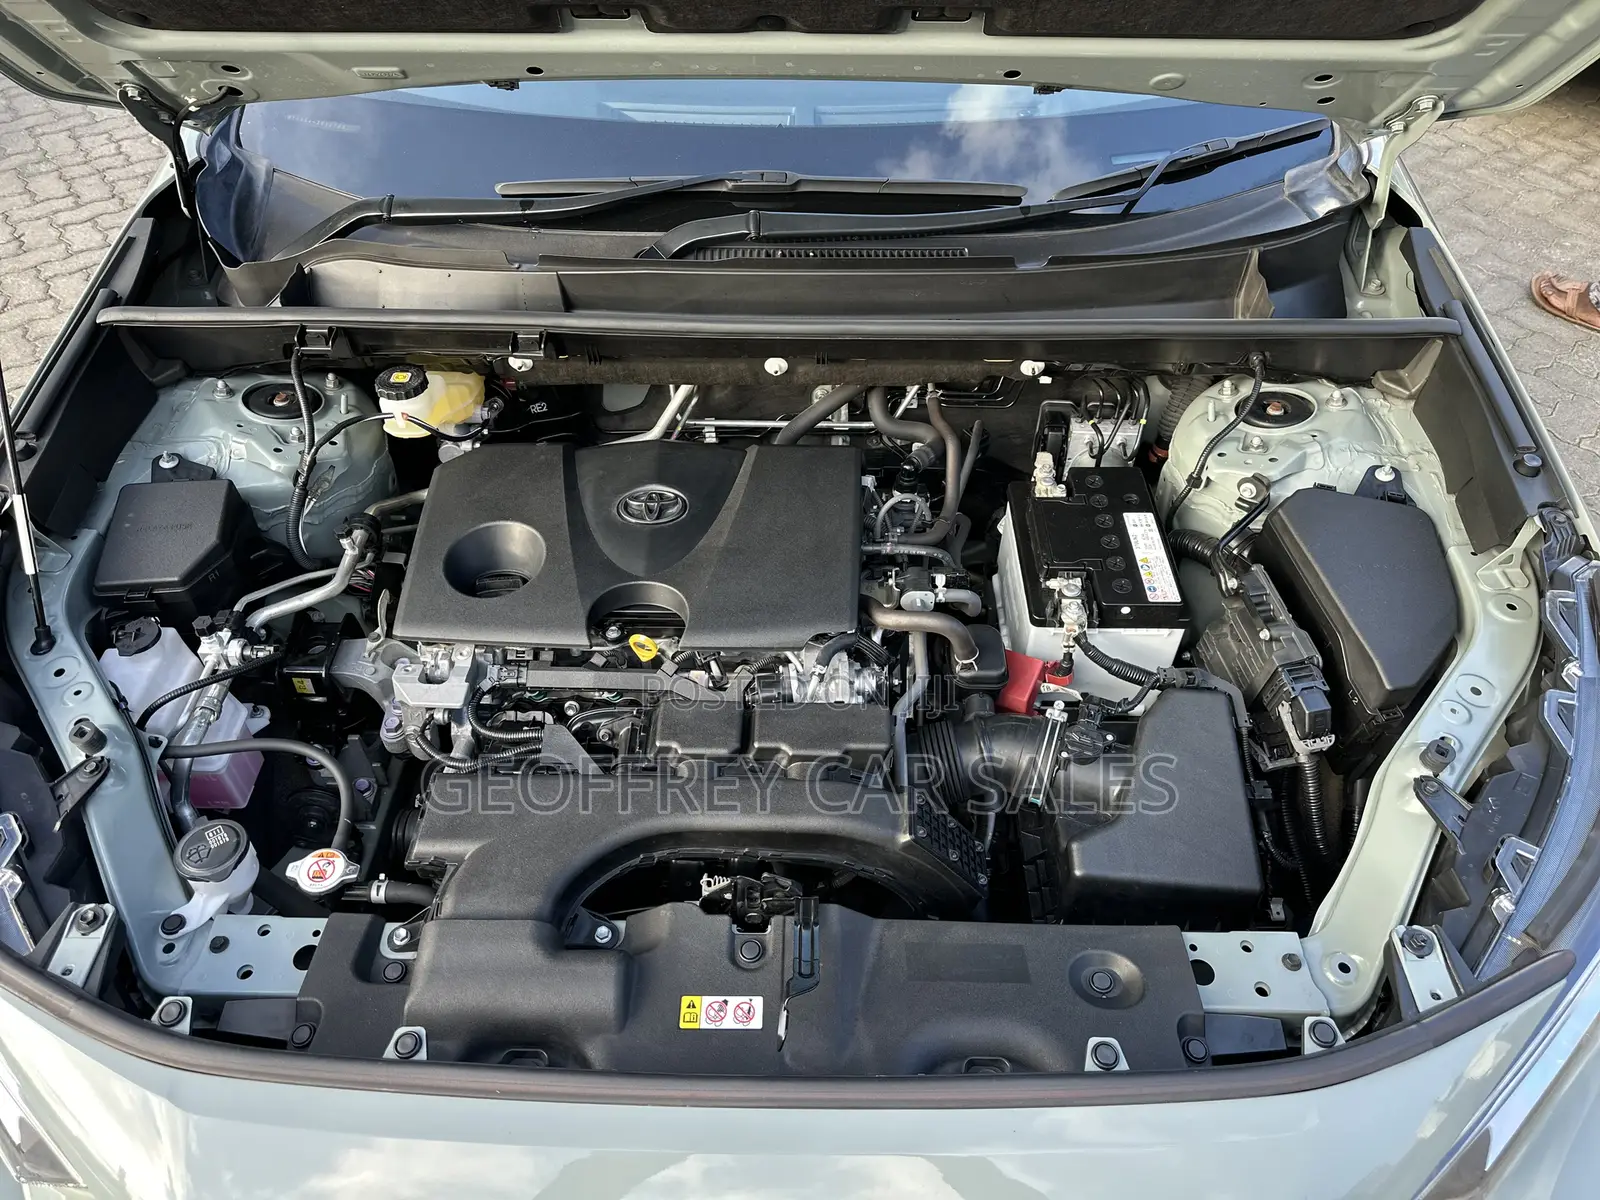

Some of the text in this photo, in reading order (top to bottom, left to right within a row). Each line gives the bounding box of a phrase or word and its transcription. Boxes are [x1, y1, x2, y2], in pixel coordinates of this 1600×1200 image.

[529, 402, 549, 414] RE2
[207, 570, 220, 582] R1
[1347, 689, 1359, 706] L2
